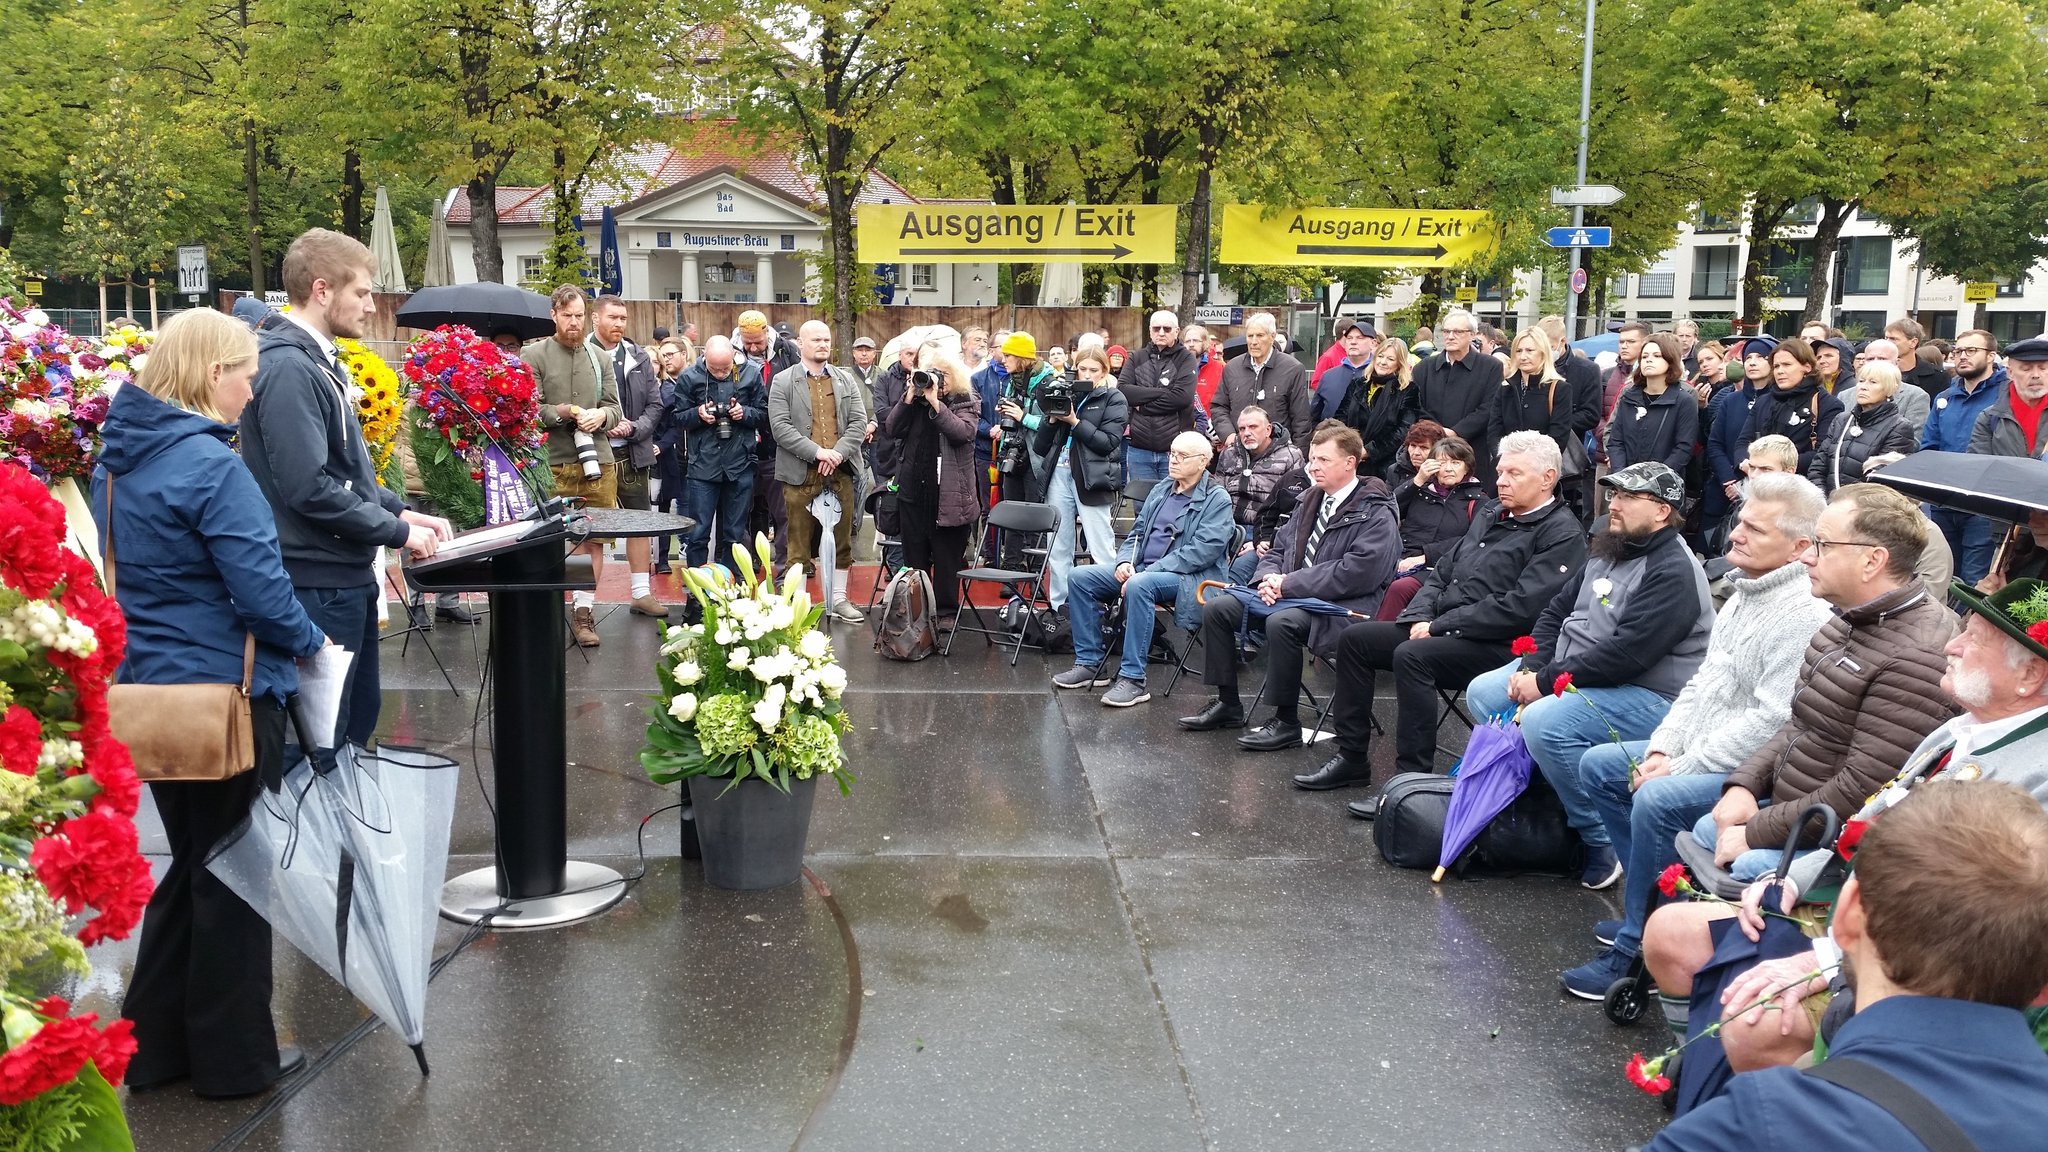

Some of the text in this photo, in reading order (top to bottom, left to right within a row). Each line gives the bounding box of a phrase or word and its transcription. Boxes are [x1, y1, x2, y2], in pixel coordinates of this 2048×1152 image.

[716, 191, 733, 201] Das
[717, 203, 733, 212] Bad
[899, 208, 1136, 243] Ausgang / Exit
[1288, 214, 1462, 241] Ausgang / Exit
[683, 232, 769, 248] Augustiner-Bräu
[1197, 310, 1229, 318] NGANG
